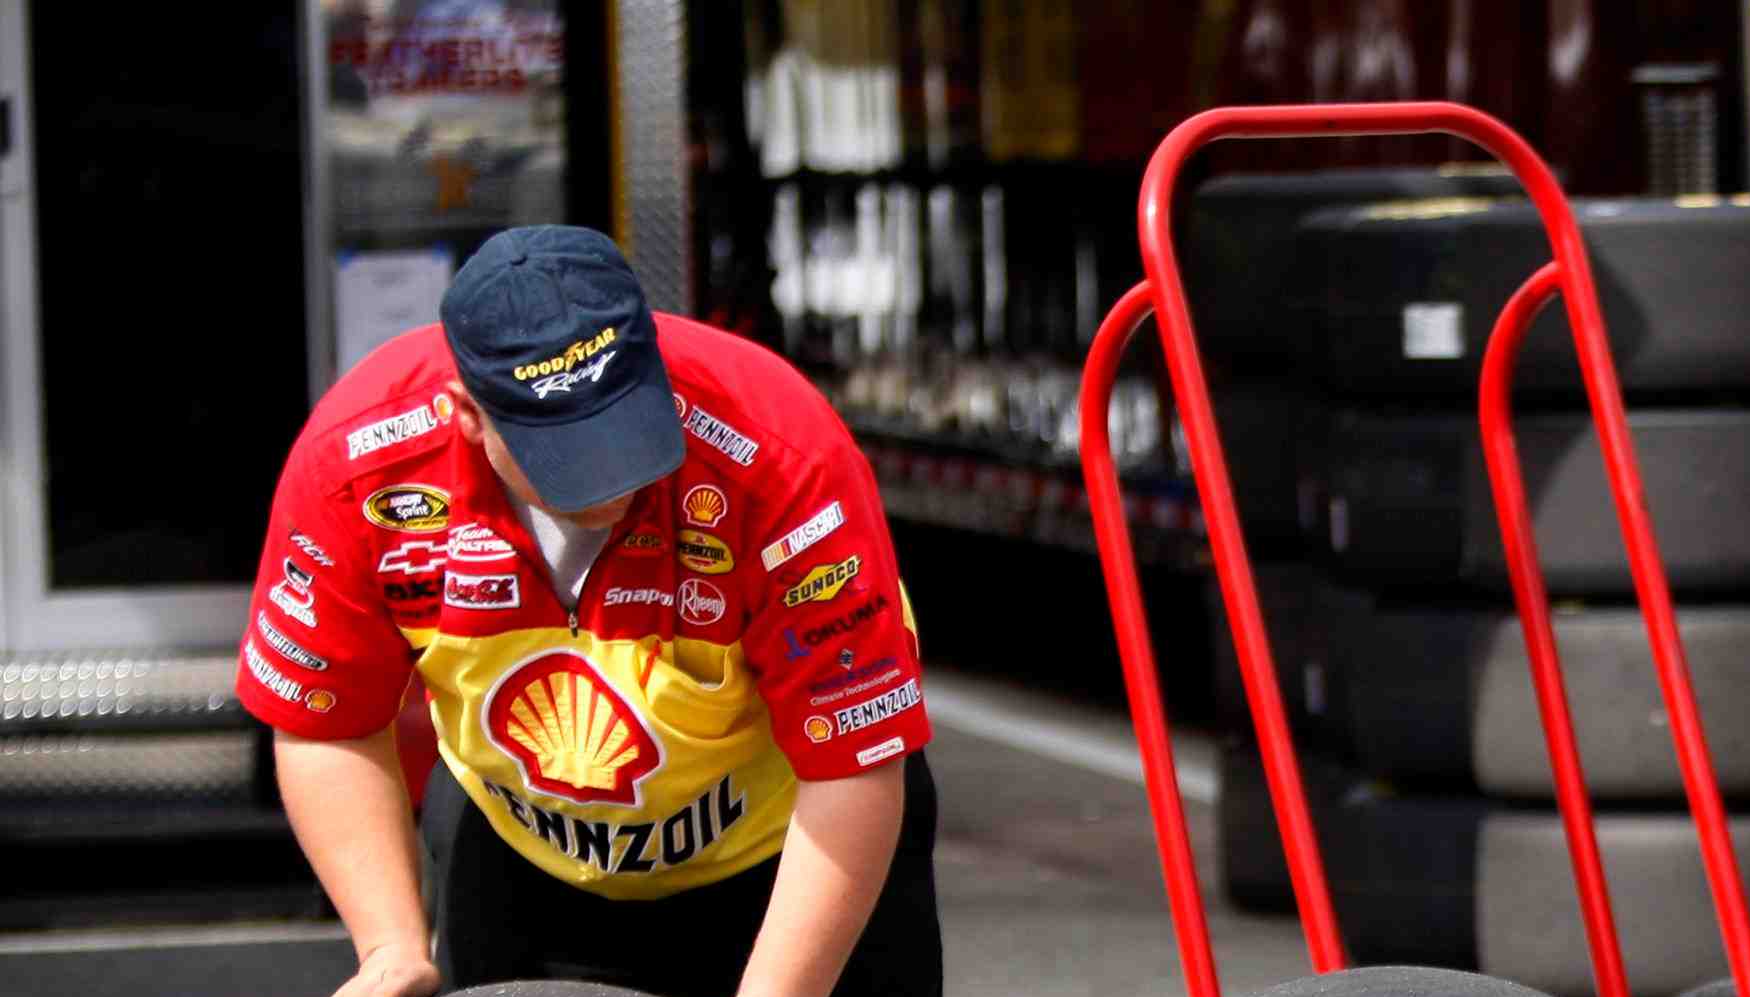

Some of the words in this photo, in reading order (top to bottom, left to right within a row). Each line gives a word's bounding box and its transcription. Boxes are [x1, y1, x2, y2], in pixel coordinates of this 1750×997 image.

[350, 405, 438, 455] PENNZOIL
[685, 409, 757, 465] PENNZOIL
[788, 559, 858, 606] SUNOCO
[837, 680, 919, 735] PENNZOIL
